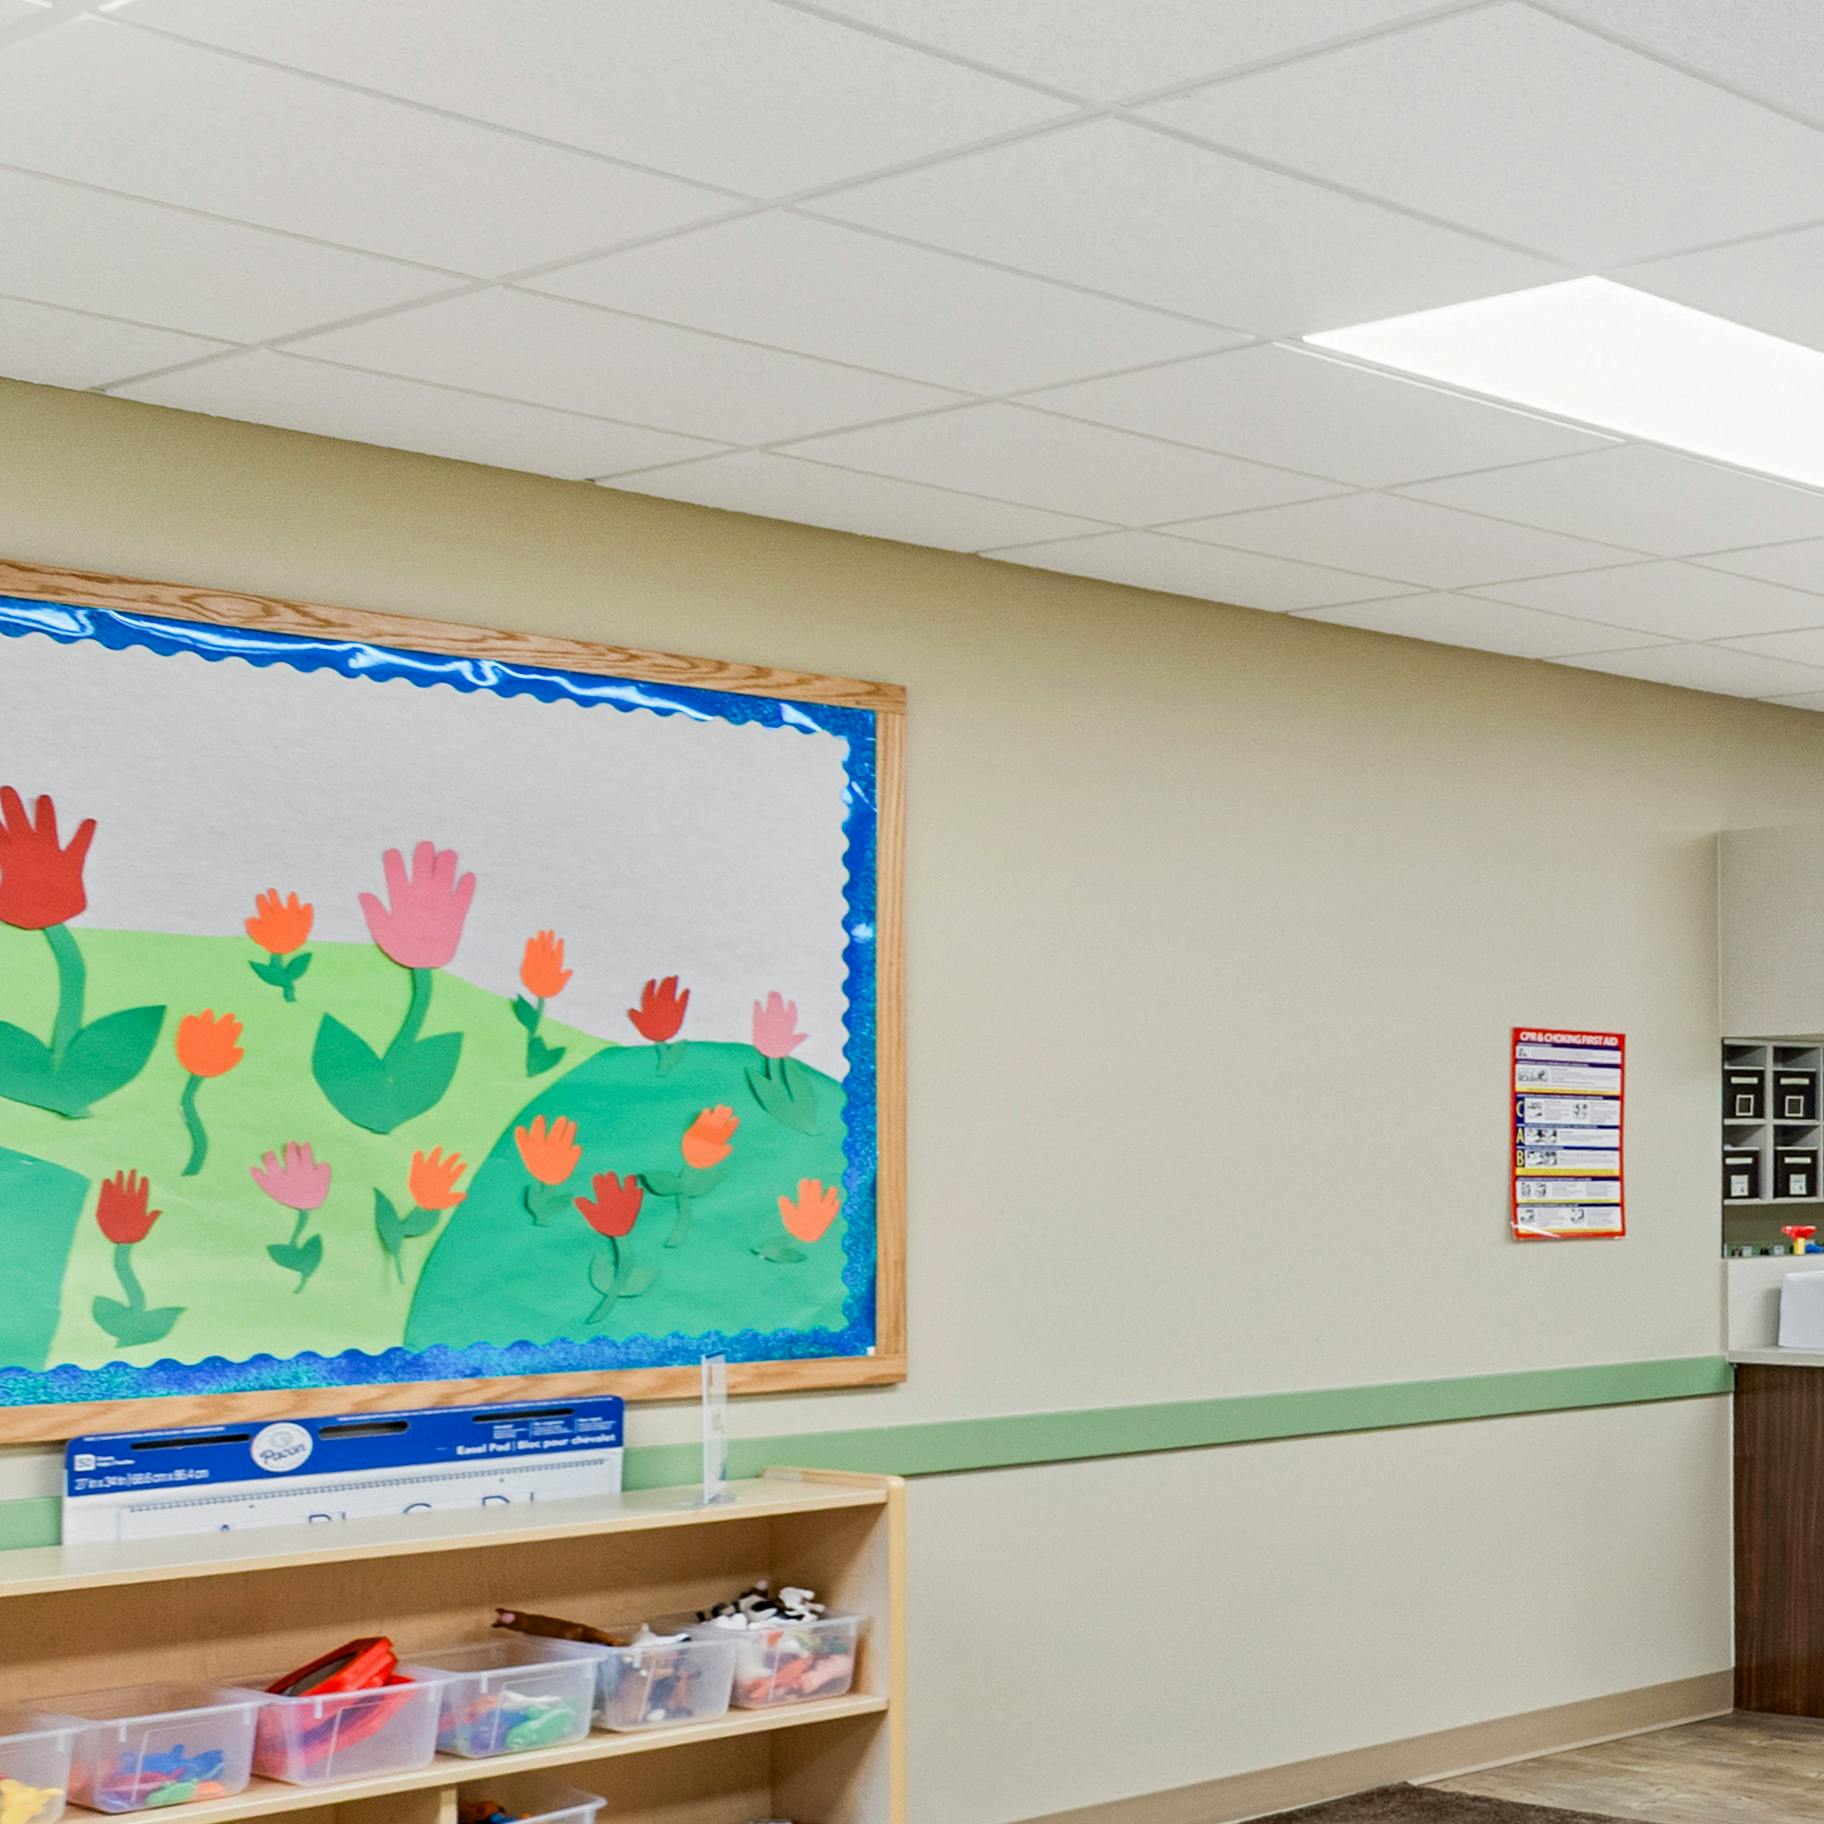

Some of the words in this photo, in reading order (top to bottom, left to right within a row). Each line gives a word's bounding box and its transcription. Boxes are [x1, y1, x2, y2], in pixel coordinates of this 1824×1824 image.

[1516, 1129, 1525, 1146] A
[1516, 1150, 1525, 1168] B
[259, 1443, 306, 1466] Pacon
[456, 1444, 487, 1455] Easel
[489, 1442, 511, 1452] Pad
[517, 1439, 541, 1450] Bloc
[543, 1437, 569, 1448] pour
